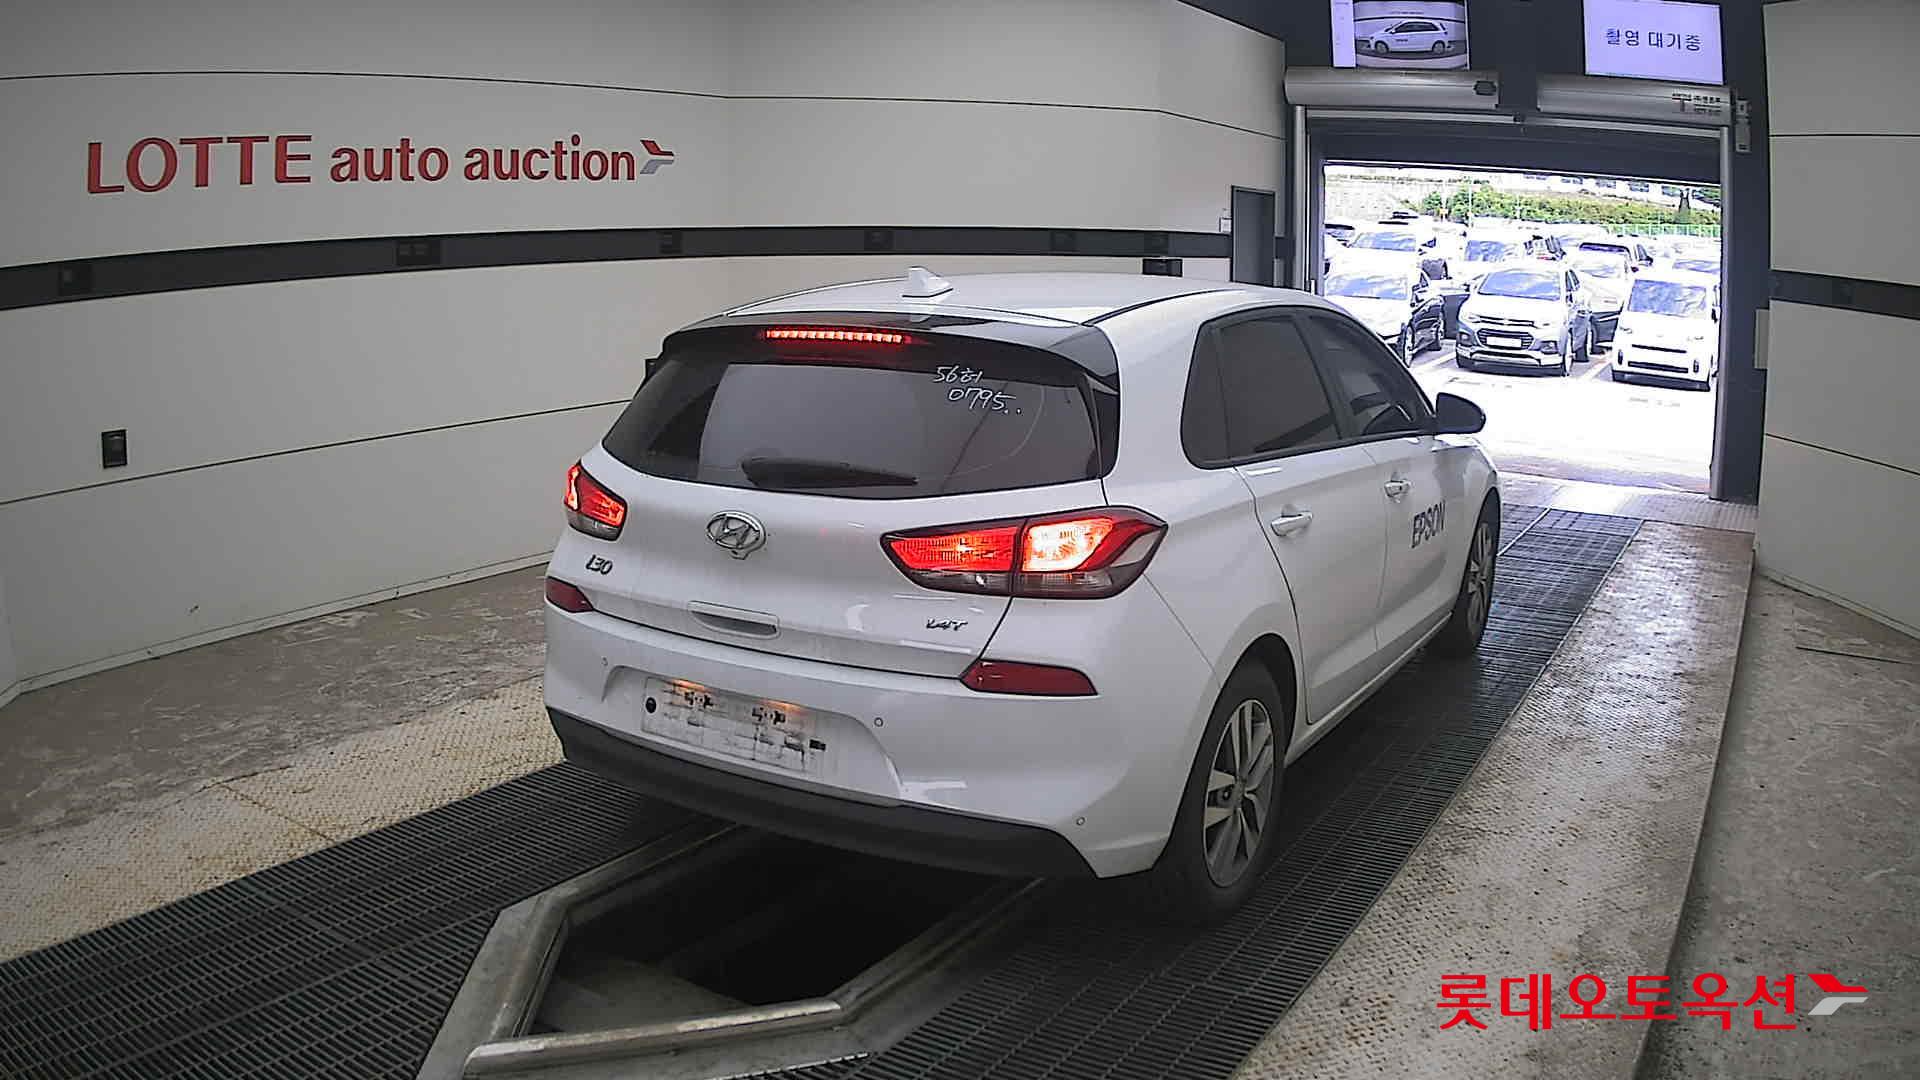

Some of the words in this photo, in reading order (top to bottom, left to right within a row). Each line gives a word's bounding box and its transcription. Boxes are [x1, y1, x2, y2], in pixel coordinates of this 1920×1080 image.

[1647, 31, 1701, 52] 대기중
[88, 134, 313, 194] LOTTE
[330, 137, 449, 183] auto
[463, 134, 637, 181] auction
[1411, 499, 1446, 549] EPSON
